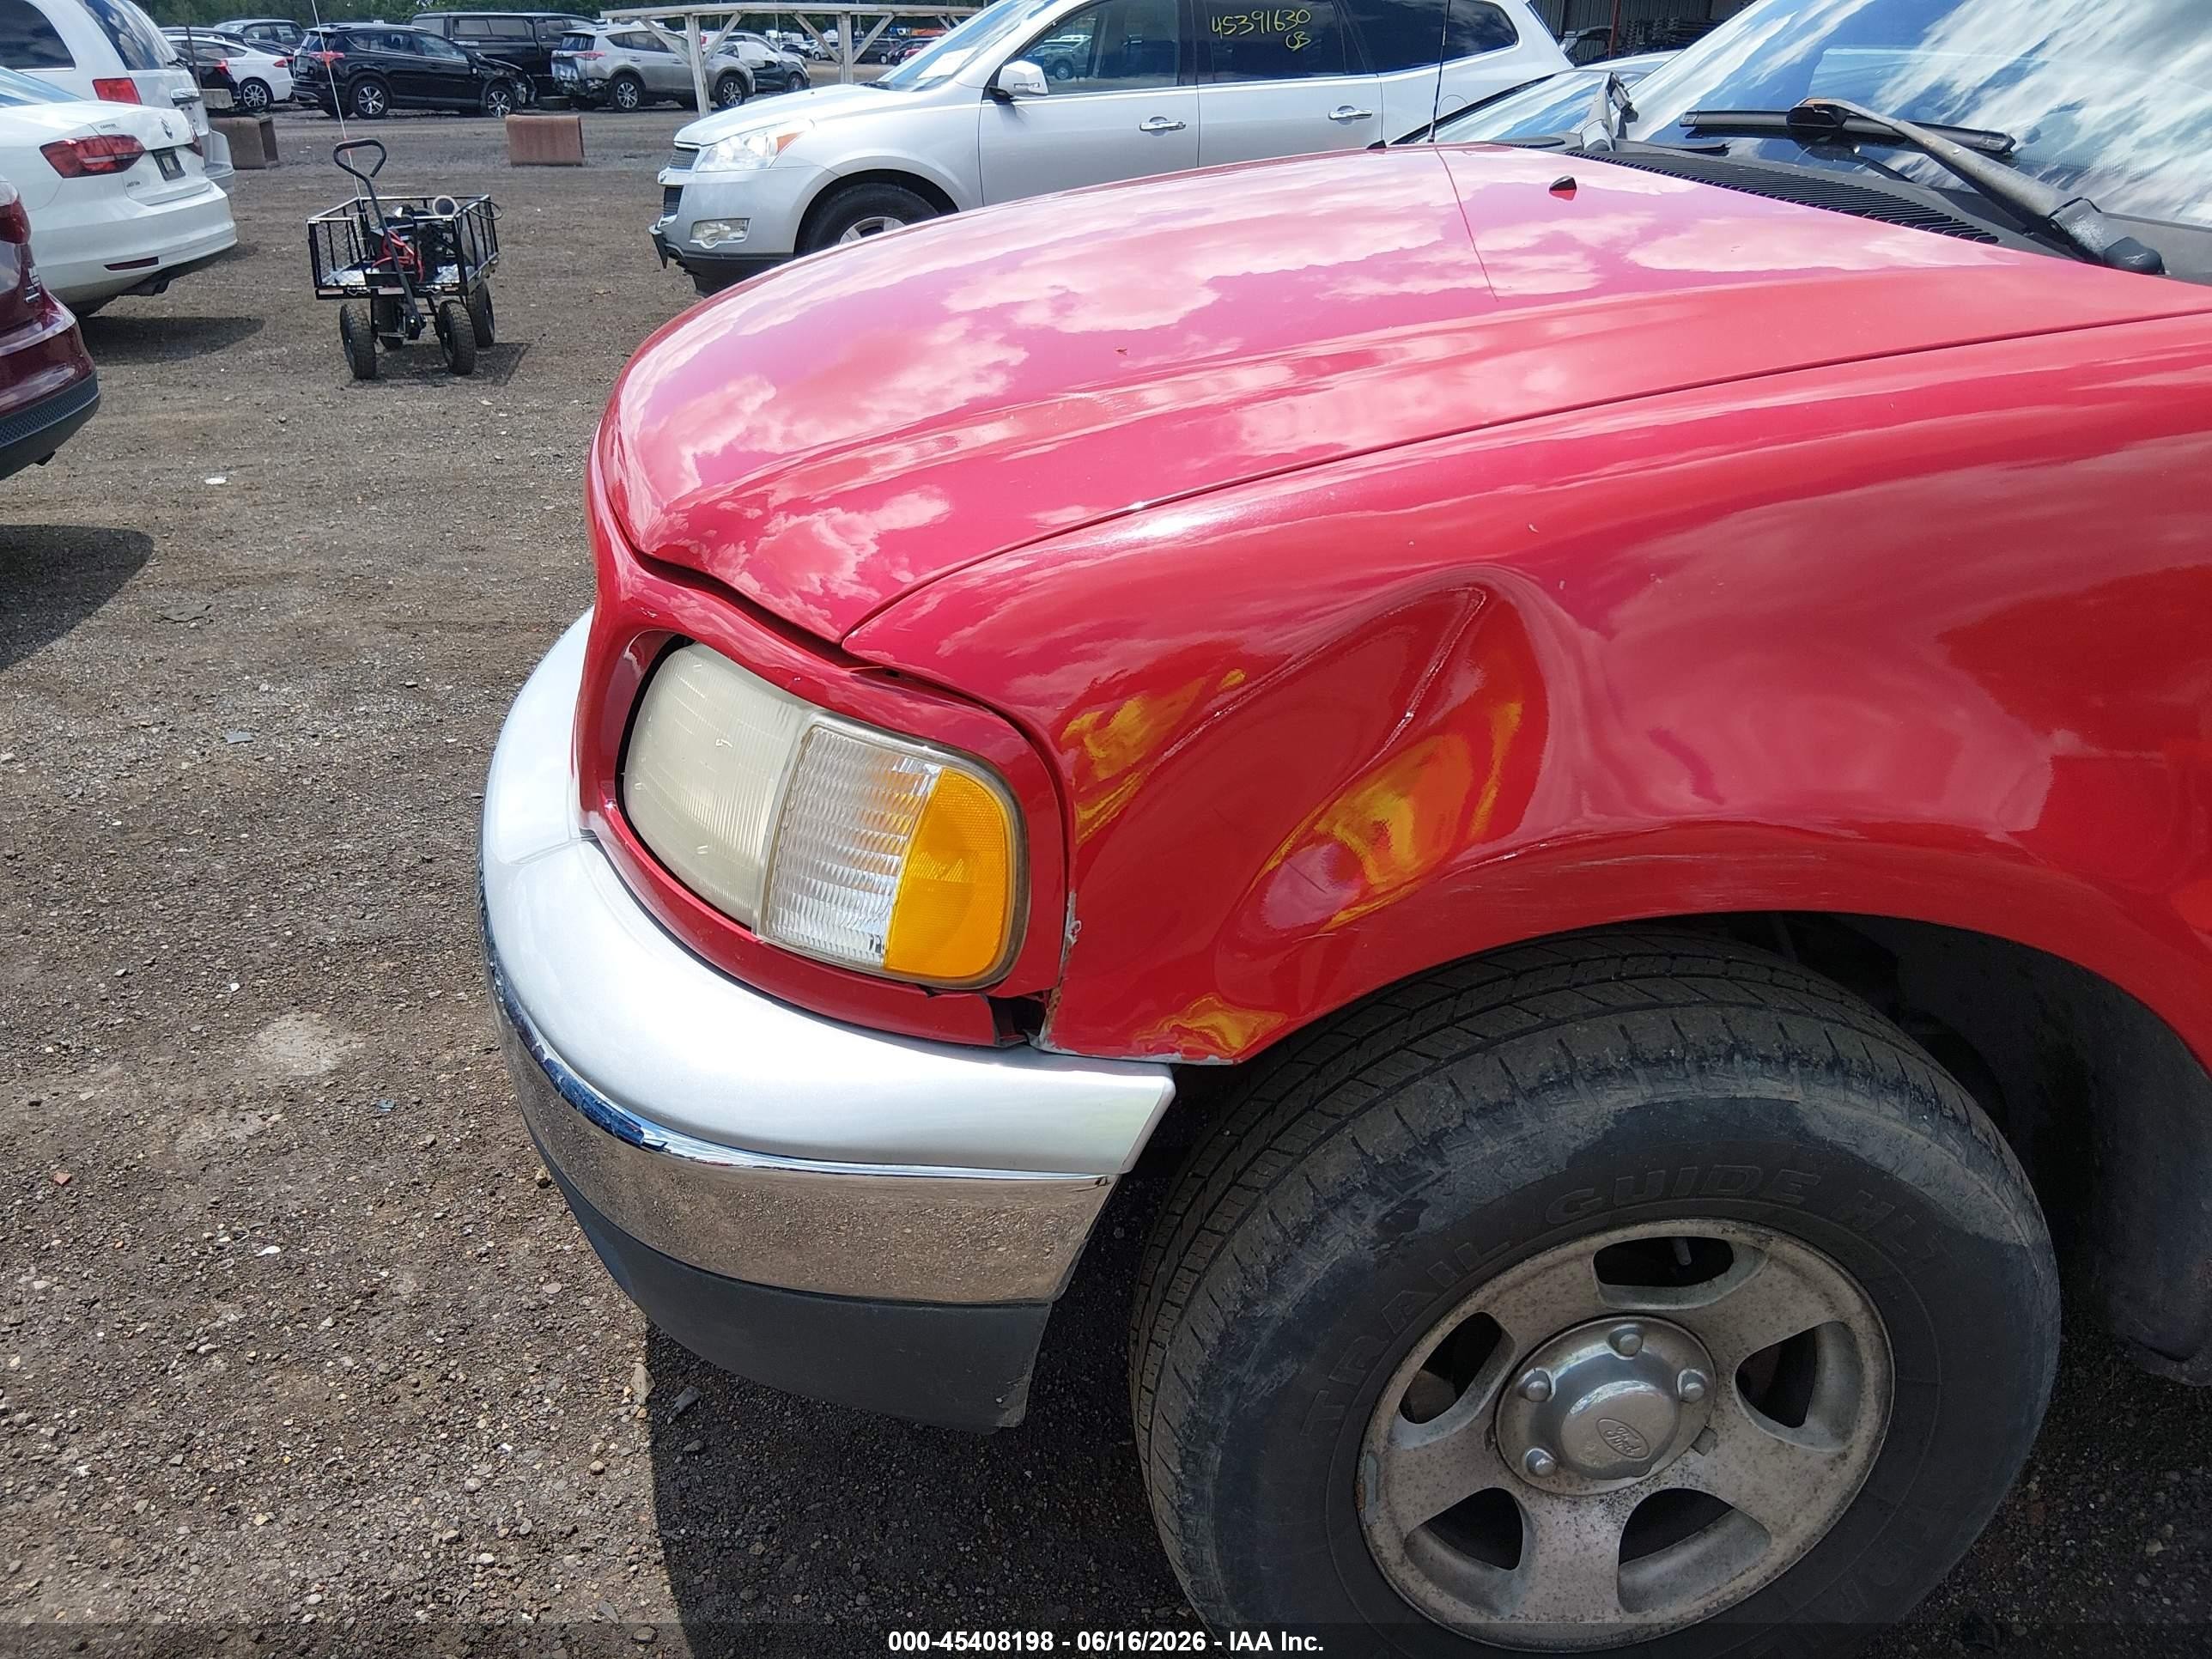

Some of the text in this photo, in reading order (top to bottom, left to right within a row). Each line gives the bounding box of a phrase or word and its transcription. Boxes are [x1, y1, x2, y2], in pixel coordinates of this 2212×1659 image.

[1212, 9, 1311, 40] 45391630
[1298, 1242, 1513, 1437] TRAIL
[1546, 1164, 1822, 1225] GUIDE
